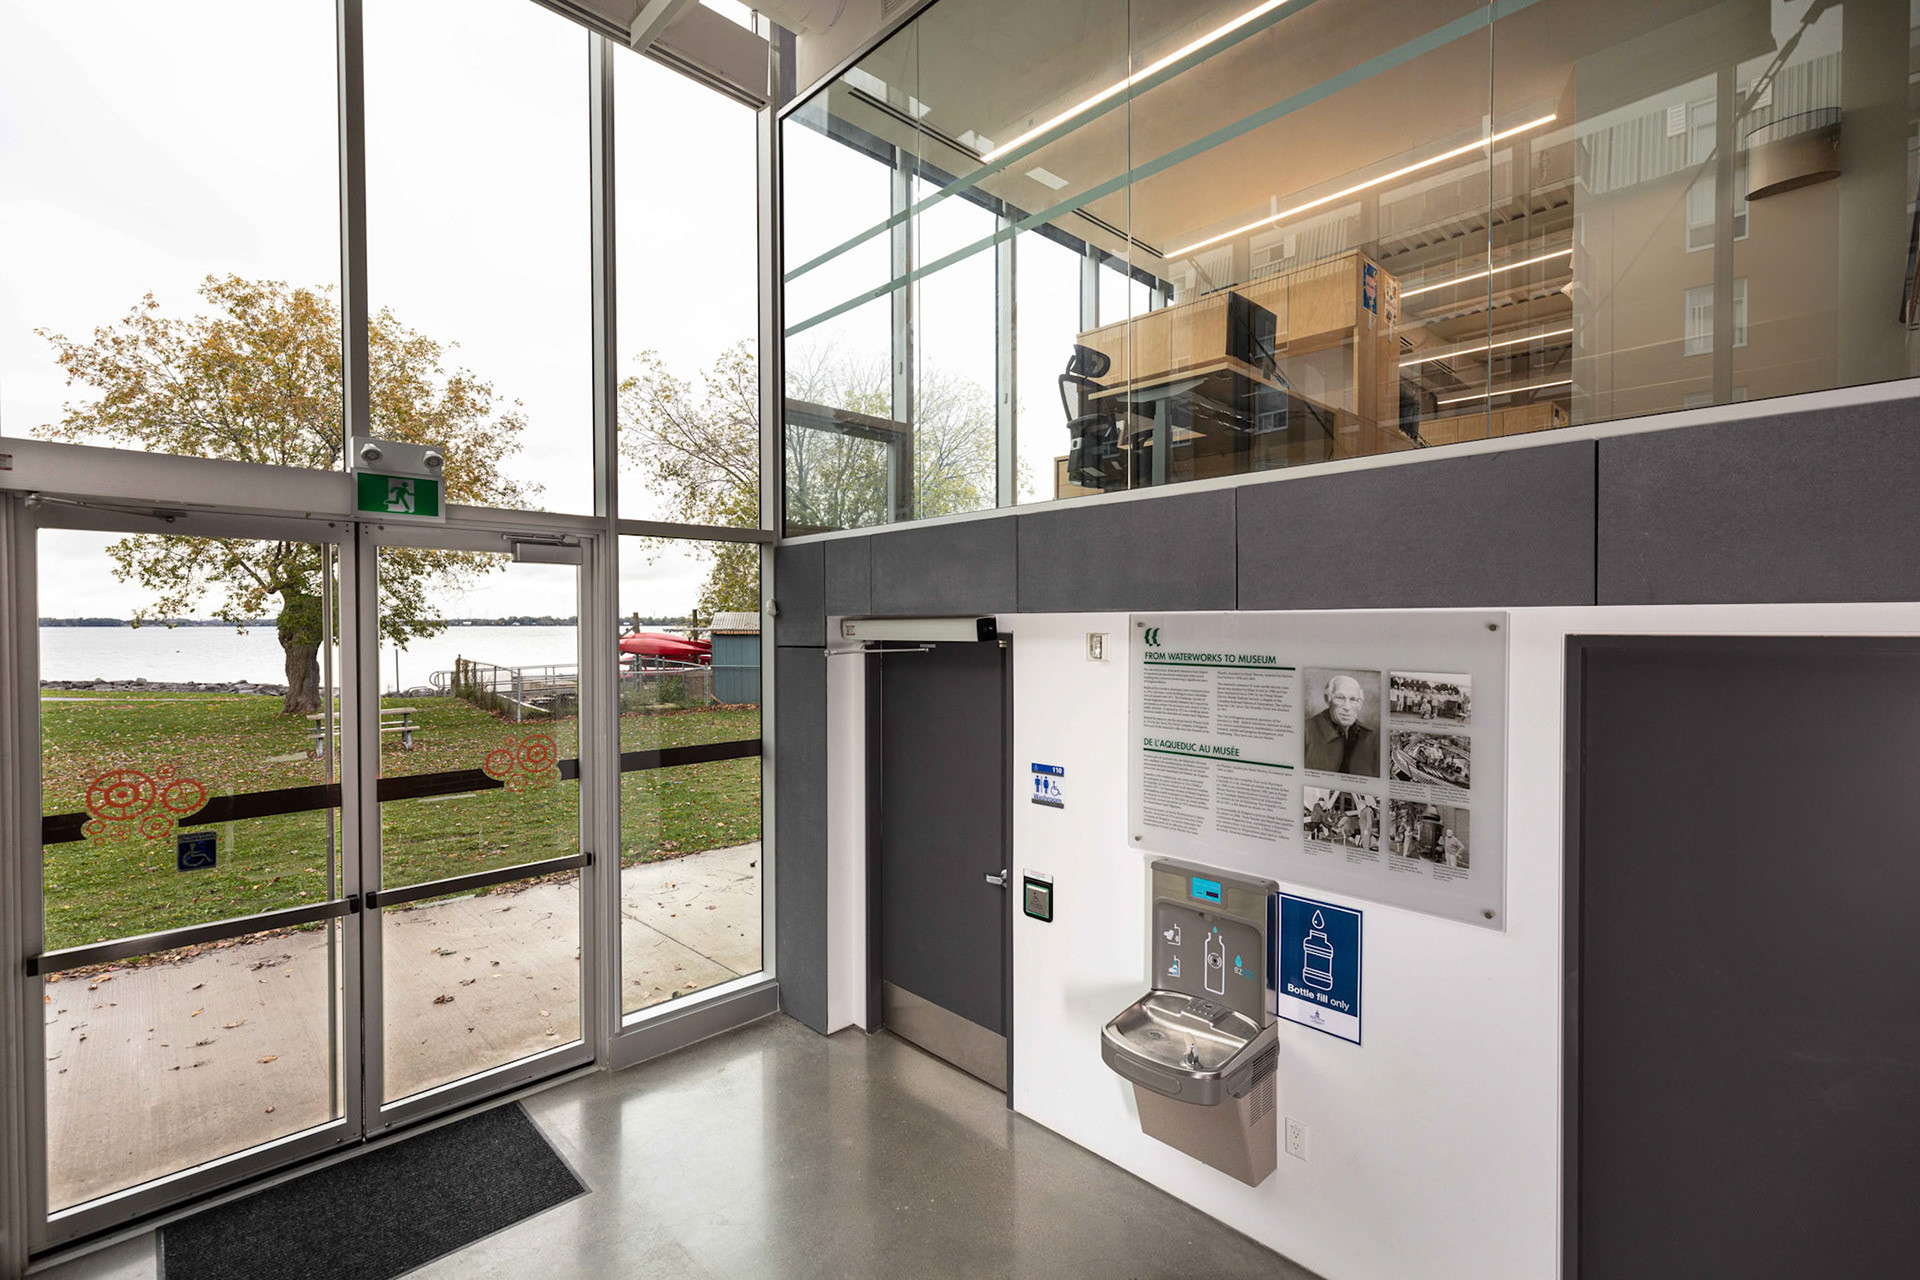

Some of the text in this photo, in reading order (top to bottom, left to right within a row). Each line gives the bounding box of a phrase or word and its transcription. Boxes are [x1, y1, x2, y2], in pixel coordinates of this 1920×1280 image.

[1145, 652, 1276, 664] FROM WATERWORKS TO MUSEUM
[1144, 738, 1240, 756] DE L'AQUEDUC AU MUSÉE
[1287, 983, 1350, 1011] Bottle fill only
